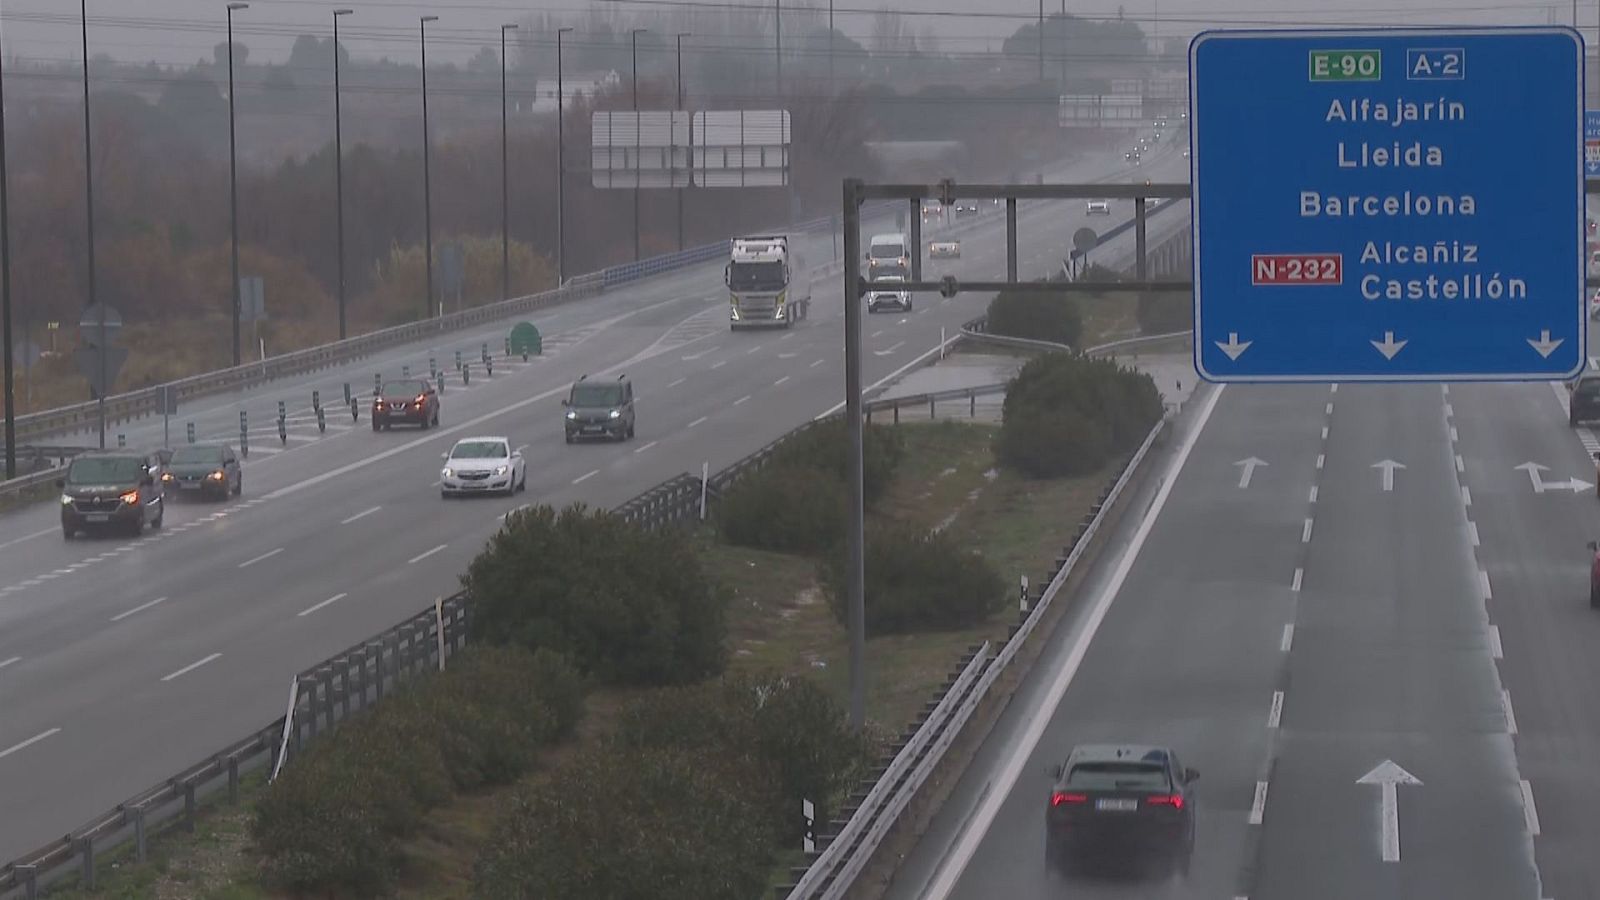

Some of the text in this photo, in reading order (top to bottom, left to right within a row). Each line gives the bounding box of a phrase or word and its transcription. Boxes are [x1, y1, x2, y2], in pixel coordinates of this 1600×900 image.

[1314, 55, 1376, 76] E-90
[1413, 54, 1460, 75] A-2
[1325, 97, 1466, 127] Alfajarín
[1337, 141, 1443, 168] Lleida
[1299, 190, 1476, 217] Barcelona
[1360, 240, 1479, 264] Alcañiz
[1256, 258, 1337, 281] N-232
[1360, 272, 1527, 300] Castellón
